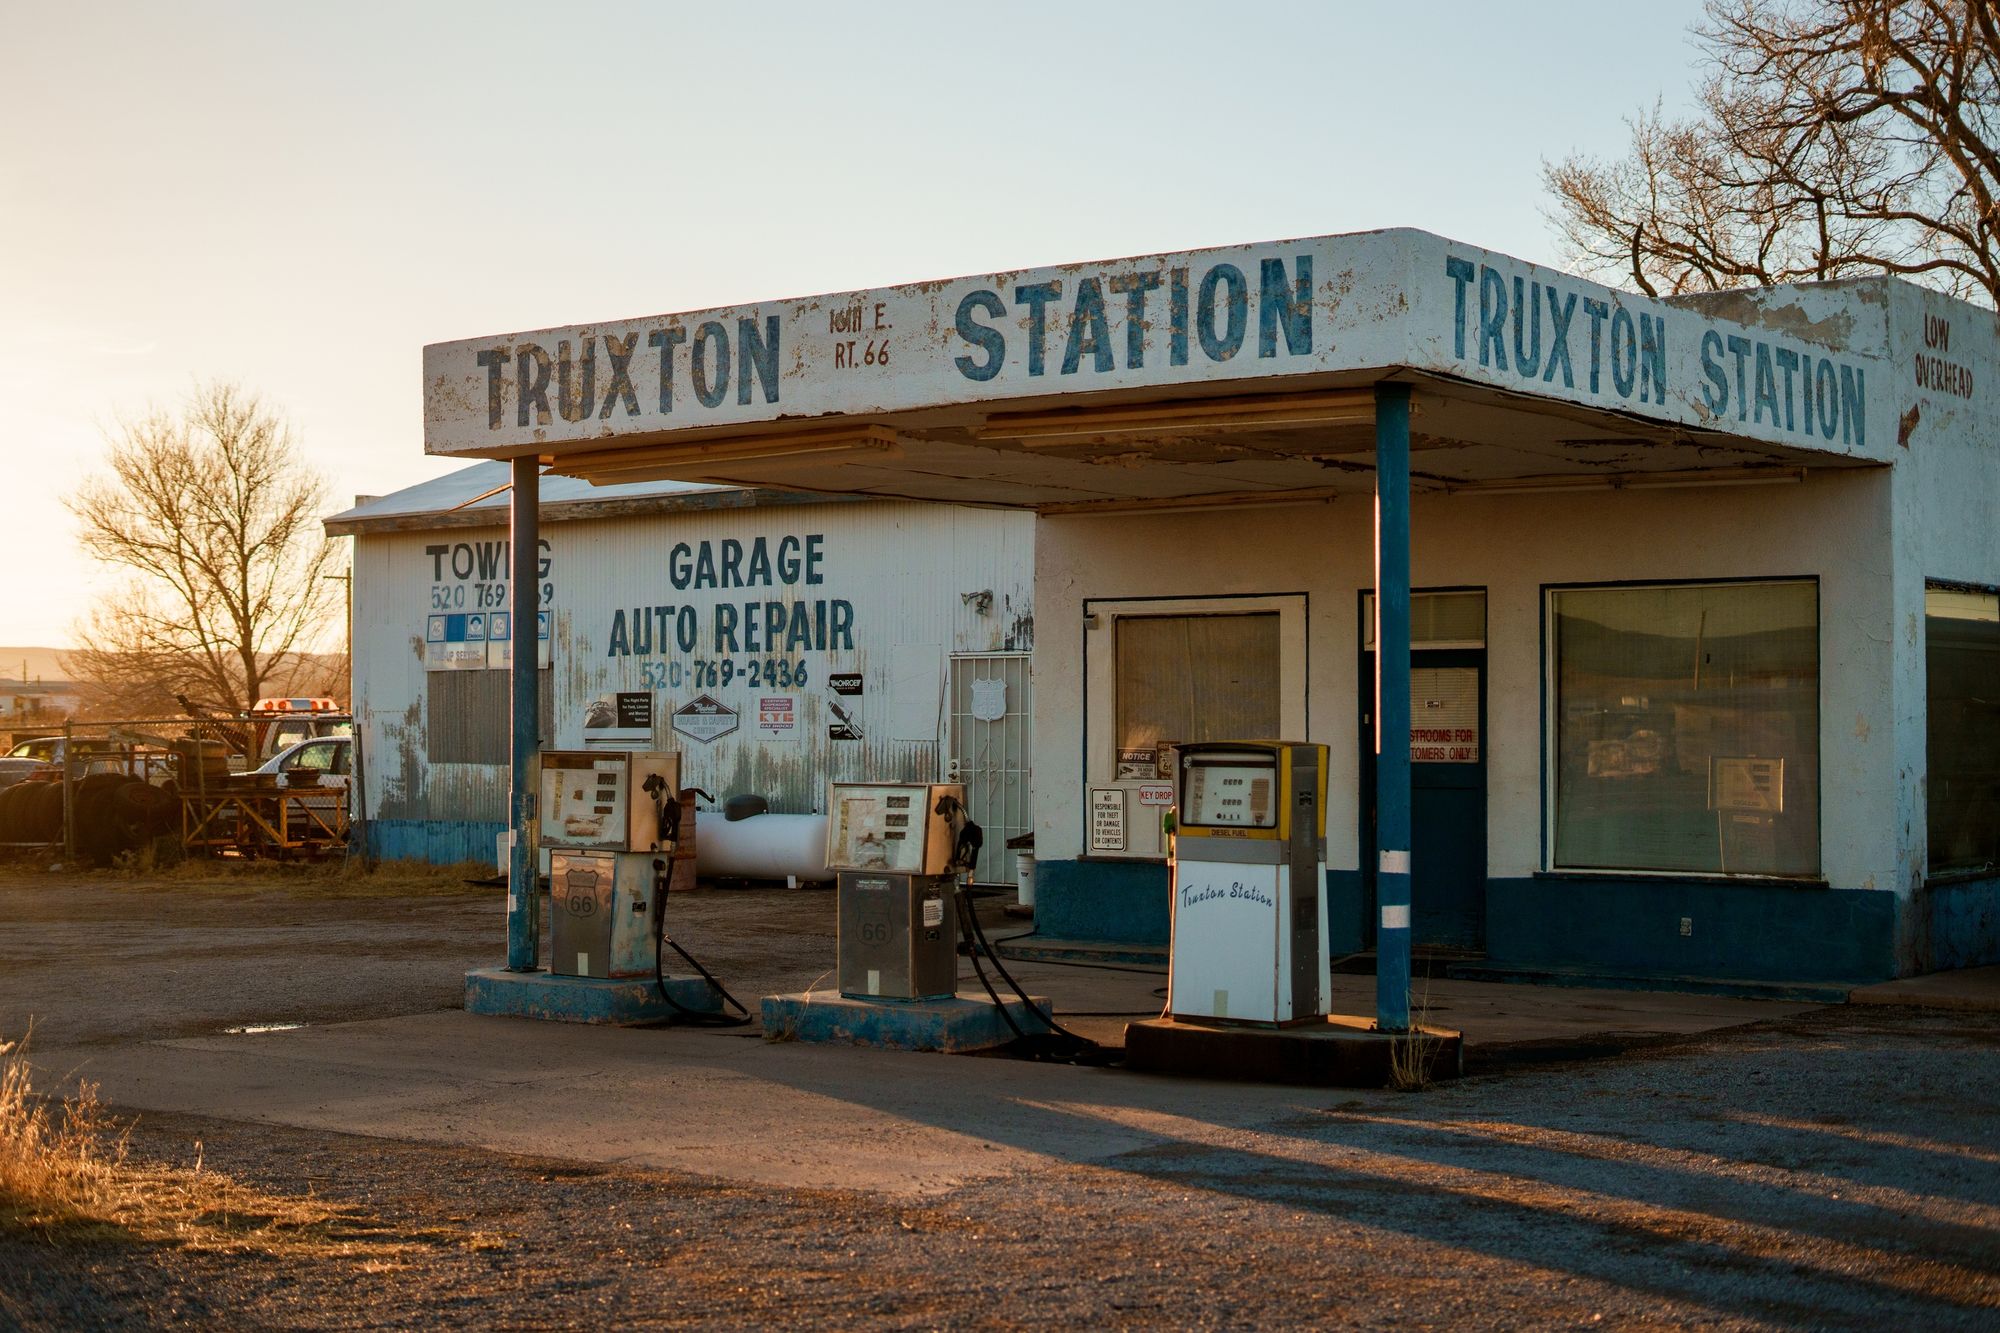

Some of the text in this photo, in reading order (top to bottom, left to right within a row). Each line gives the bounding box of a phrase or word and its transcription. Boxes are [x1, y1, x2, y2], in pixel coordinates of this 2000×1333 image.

[477, 255, 1313, 430] TRUXTON STATION
[1924, 312, 1950, 352] LOW
[864, 339, 889, 366] 66
[1446, 255, 1866, 446] TRUXTON STATION
[1915, 352, 1973, 400] OVERHEAD
[426, 539, 551, 581] TOWIG
[669, 534, 824, 590] GARAGE
[432, 583, 505, 609] 520 769
[608, 600, 854, 657] AUTO REPAIR
[1410, 729, 1472, 743] STROOMS FOR
[1122, 752, 1151, 761] NOTICE
[1411, 747, 1445, 760] TOMERS
[1449, 747, 1471, 760] ONLY
[1140, 791, 1172, 799] KEY DROP
[1211, 829, 1247, 837] DIESEL FUEL
[570, 895, 592, 912] 66
[1229, 881, 1273, 907] Station
[863, 923, 886, 941] 66
